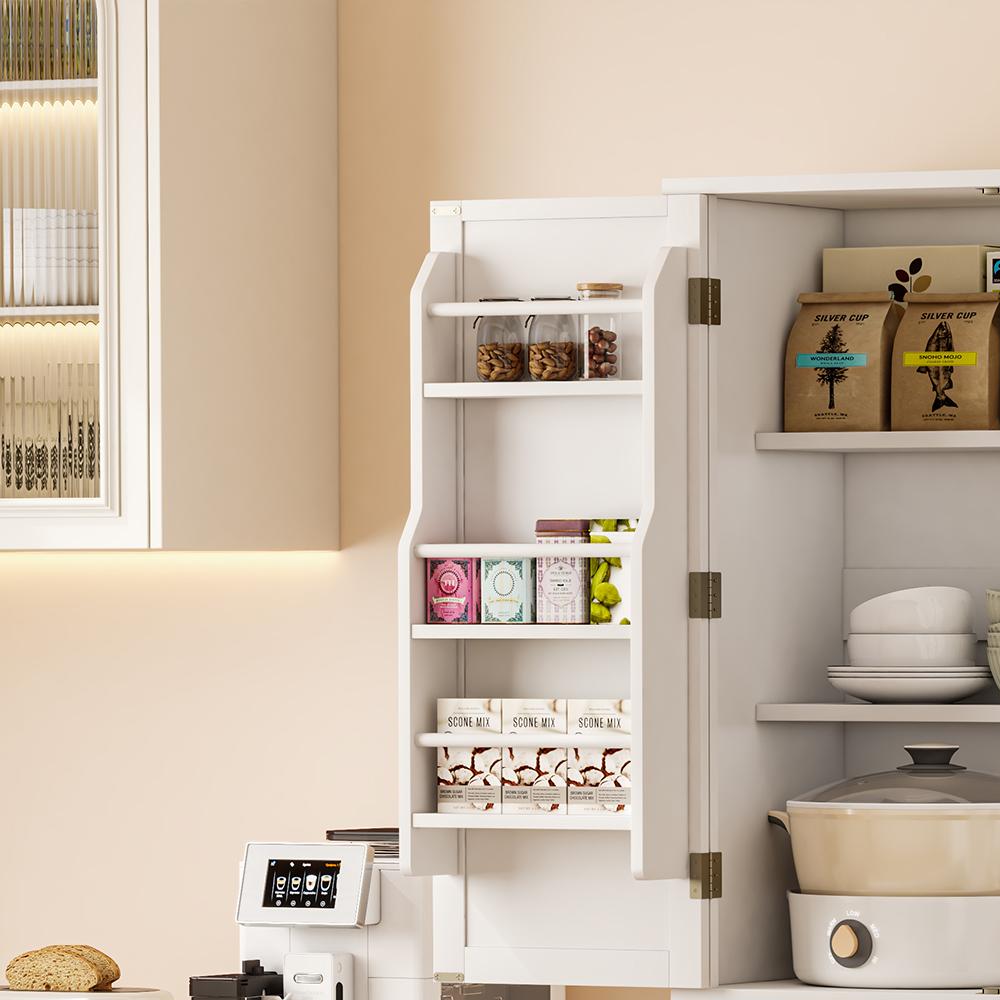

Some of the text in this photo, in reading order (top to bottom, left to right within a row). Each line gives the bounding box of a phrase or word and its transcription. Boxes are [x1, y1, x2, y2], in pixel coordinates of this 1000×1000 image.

[814, 314, 870, 322] SILVER CUP
[920, 312, 976, 320] SILVER CUP
[447, 716, 490, 728] SCONE MIX
[512, 716, 556, 728] SCONE MIX
[578, 717, 622, 728] SCONE MIX
